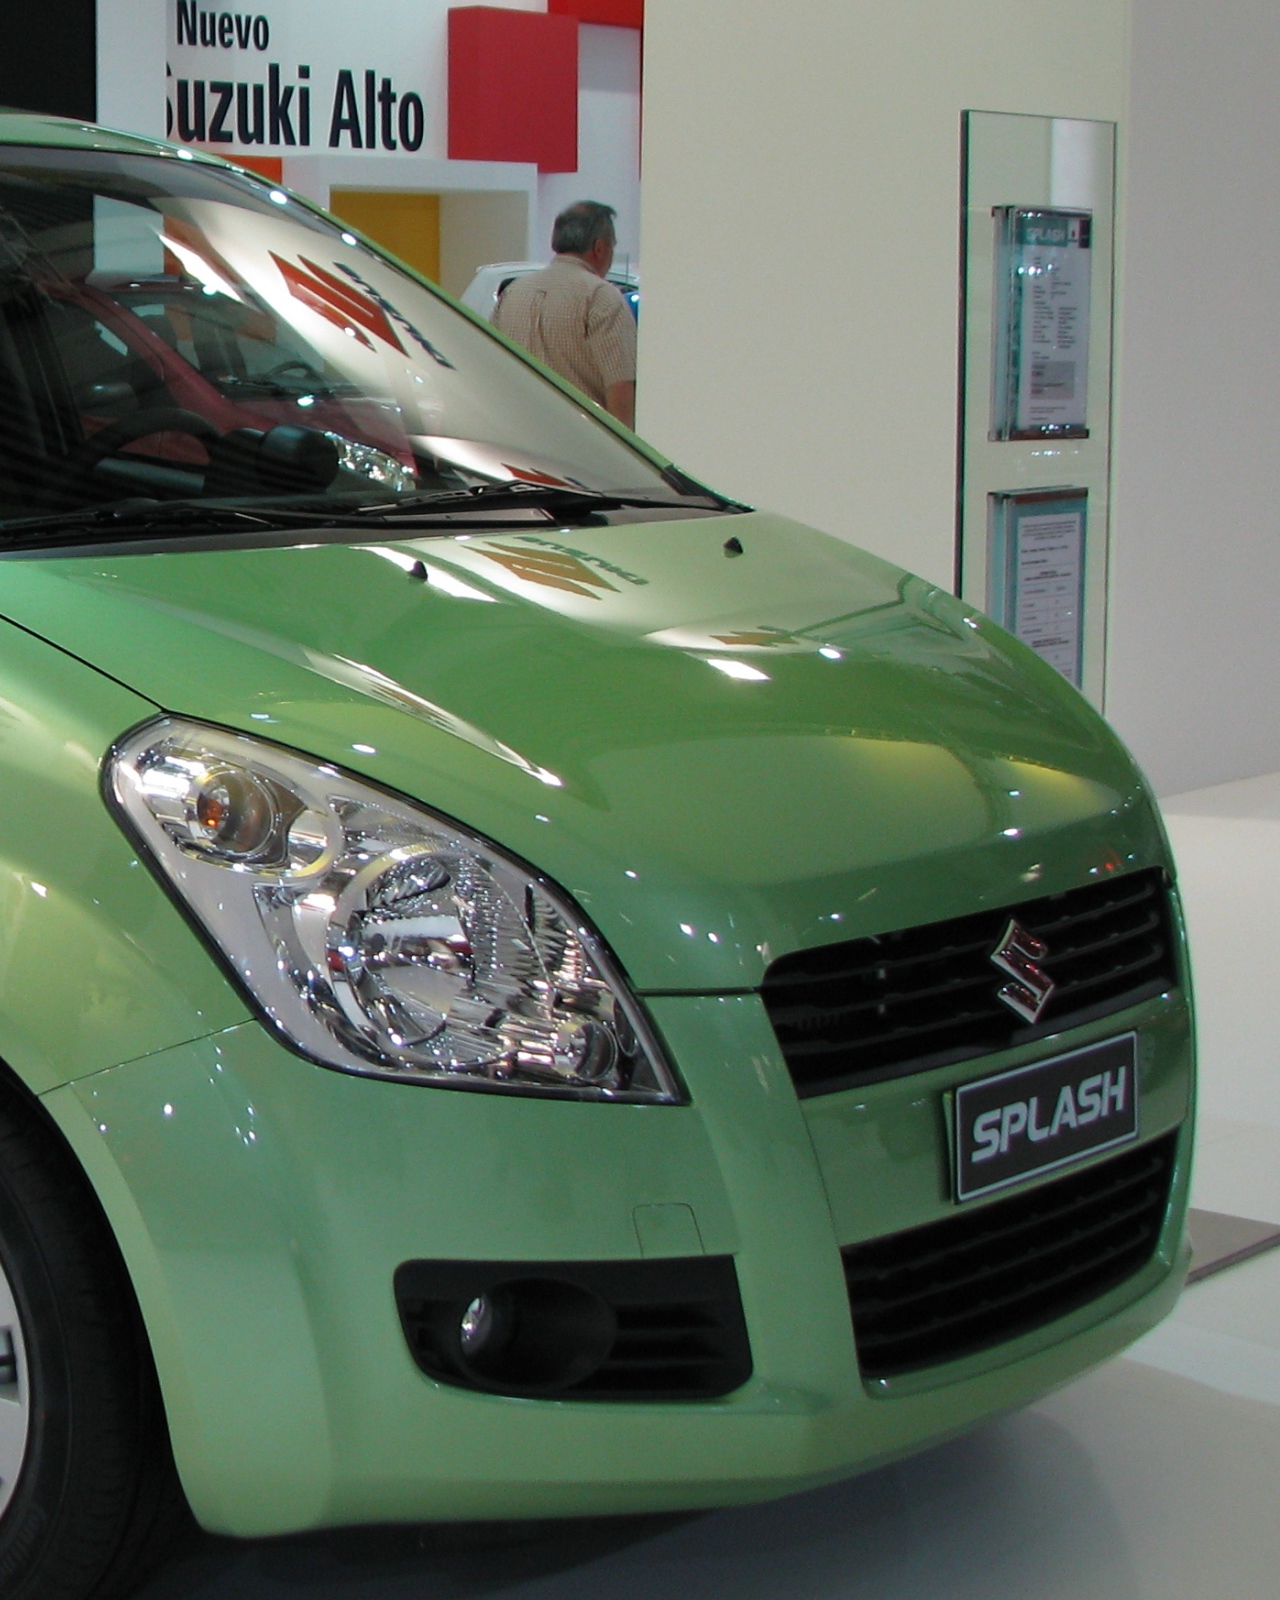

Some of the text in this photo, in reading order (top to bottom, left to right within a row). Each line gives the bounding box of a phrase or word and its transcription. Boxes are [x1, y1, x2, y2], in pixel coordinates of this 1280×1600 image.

[176, 0, 269, 51] Nuevo
[166, 61, 424, 152] uzuki Alto
[971, 1065, 1127, 1163] SPLASH
